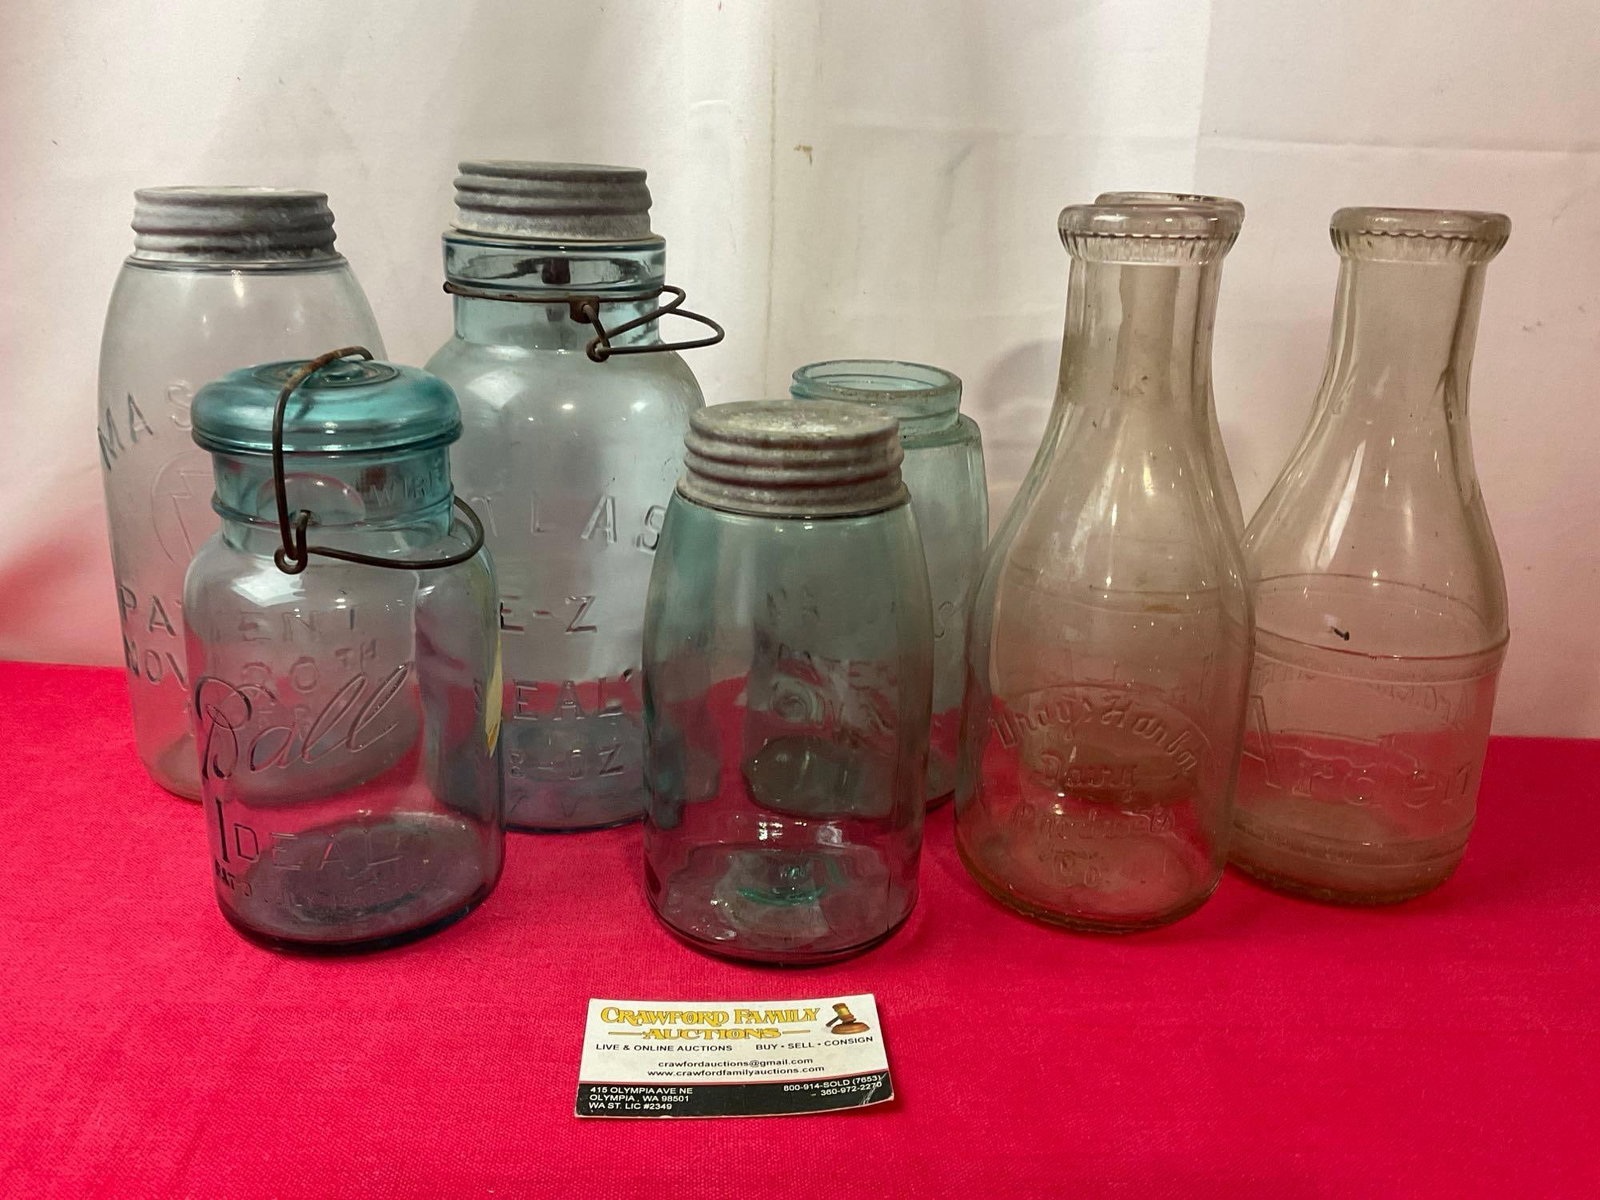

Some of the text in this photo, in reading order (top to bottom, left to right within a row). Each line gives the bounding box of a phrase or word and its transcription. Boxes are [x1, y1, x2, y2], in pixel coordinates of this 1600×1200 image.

[466, 490, 668, 554] TLAS
[500, 595, 597, 634] E-Z
[195, 662, 409, 780] Ball
[214, 797, 403, 880] IDEAL
[733, 1008, 820, 1024] FAMILY
[823, 1036, 874, 1047] CONSIGN
[647, 1065, 825, 1077] www.crawfordfamilyauctions.com
[658, 1057, 814, 1069] crawfordauctions@gmail.com
[589, 1086, 693, 1095] 415 OLYMPIA AVE NE
[783, 1074, 882, 1092] 800-914-SOLD (7653)
[820, 1081, 882, 1097] 360-972-2270
[588, 1102, 606, 1110] WA
[625, 1102, 641, 1110] LIC
[642, 1095, 659, 1103] WA
[661, 1095, 690, 1103] 98501
